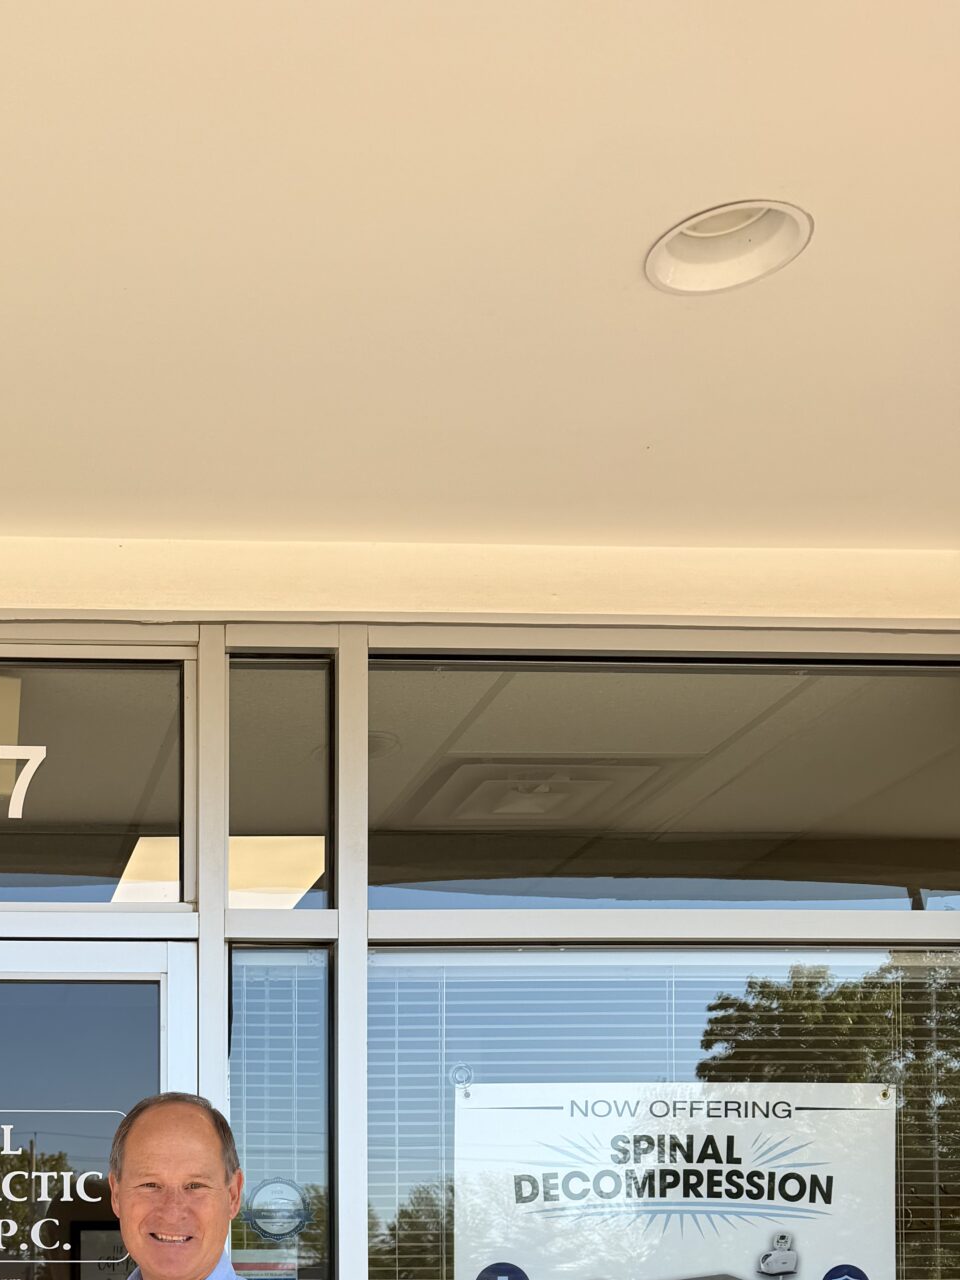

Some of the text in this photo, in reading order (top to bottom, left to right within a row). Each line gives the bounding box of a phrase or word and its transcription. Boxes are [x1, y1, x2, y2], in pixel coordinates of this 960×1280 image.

[570, 1100, 792, 1119] NOW OFFERING
[610, 1134, 743, 1165] SPINAL
[513, 1169, 834, 1205] DECOMPRESSION
